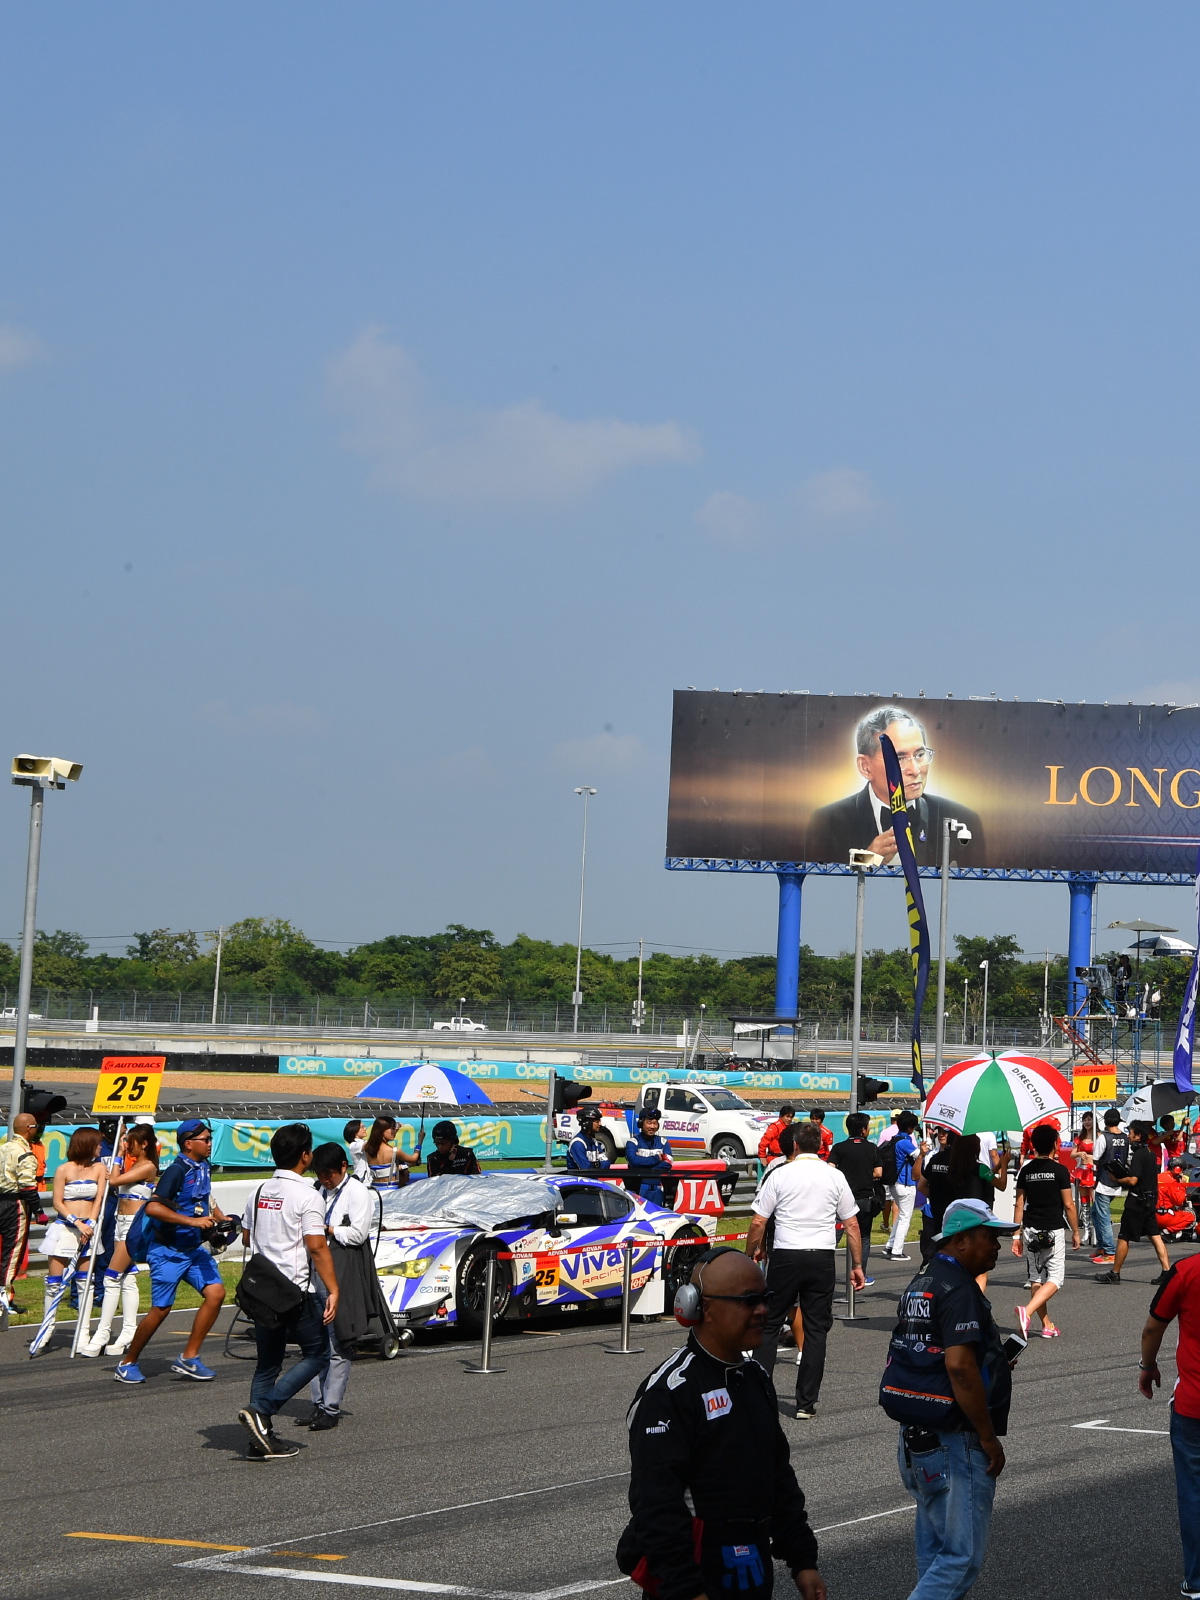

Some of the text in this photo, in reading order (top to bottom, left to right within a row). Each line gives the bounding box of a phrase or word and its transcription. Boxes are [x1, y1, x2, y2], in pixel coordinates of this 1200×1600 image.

[287, 1057, 326, 1073] Open
[343, 1058, 382, 1074] Open
[458, 1061, 498, 1078] Open
[572, 1066, 613, 1082] Open
[629, 1067, 669, 1084] Open
[687, 1069, 726, 1085] Open
[743, 1071, 783, 1087] Open
[799, 1072, 839, 1090] Open
[106, 1076, 149, 1102] 25
[1011, 1067, 1046, 1111] DIRECTION
[1088, 1077, 1100, 1094] 0
[560, 1115, 571, 1128] 2
[662, 1119, 700, 1133] RESCUE CAR
[558, 1130, 573, 1140] BRIC
[1112, 1138, 1126, 1147] 262
[1025, 1172, 1055, 1180] DIRECTION
[460, 1253, 475, 1285] ADVAN
[536, 1269, 556, 1286] 25
[707, 1395, 728, 1412] au
[645, 1425, 666, 1434] PUMA
